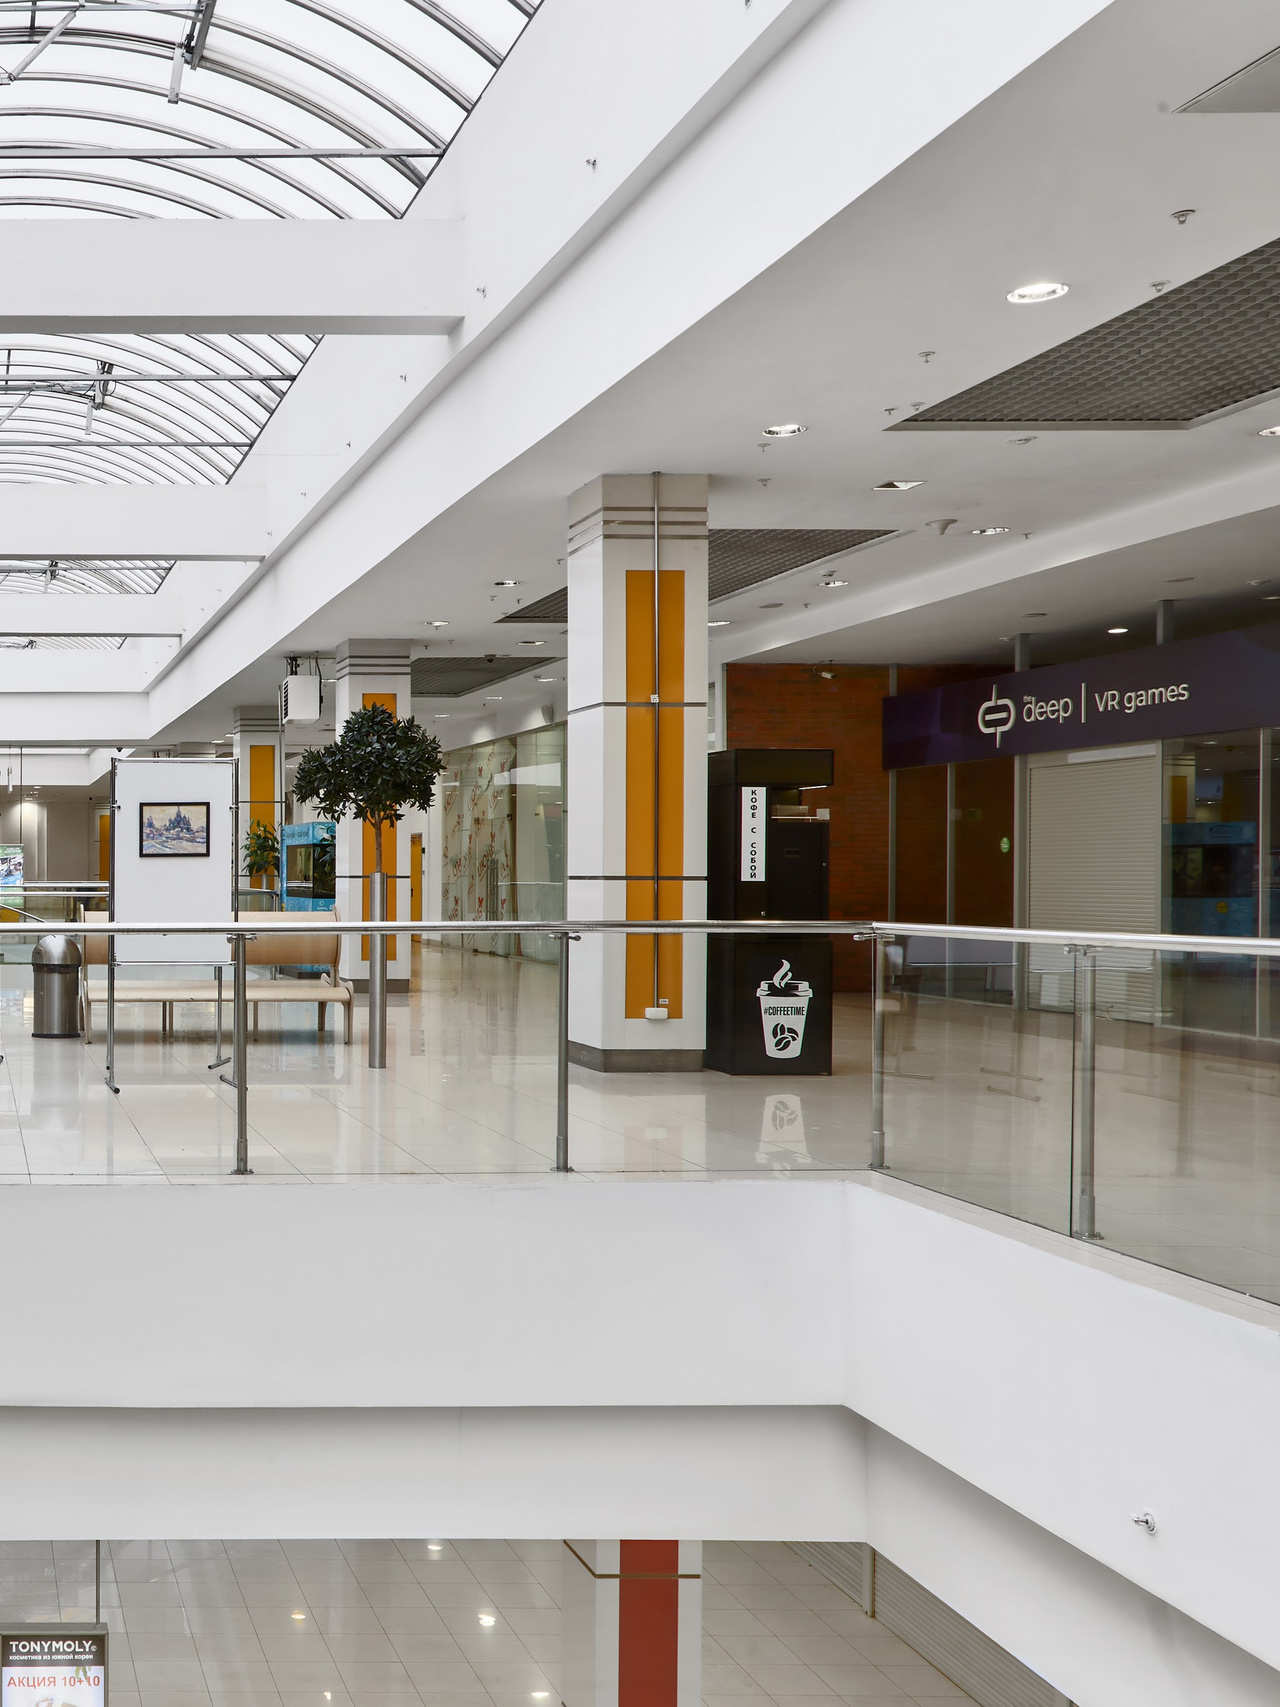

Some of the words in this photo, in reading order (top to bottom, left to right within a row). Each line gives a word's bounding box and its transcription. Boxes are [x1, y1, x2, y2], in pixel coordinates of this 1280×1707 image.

[1023, 696, 1073, 724] deep
[1095, 690, 1120, 712] VR
[1124, 684, 1190, 713] games
[750, 789, 758, 819] КОФЕ
[763, 1006, 805, 1016] #COFFEETIME
[7, 1676, 56, 1689] АКЦИЯ
[62, 1675, 100, 1687] 10+10
